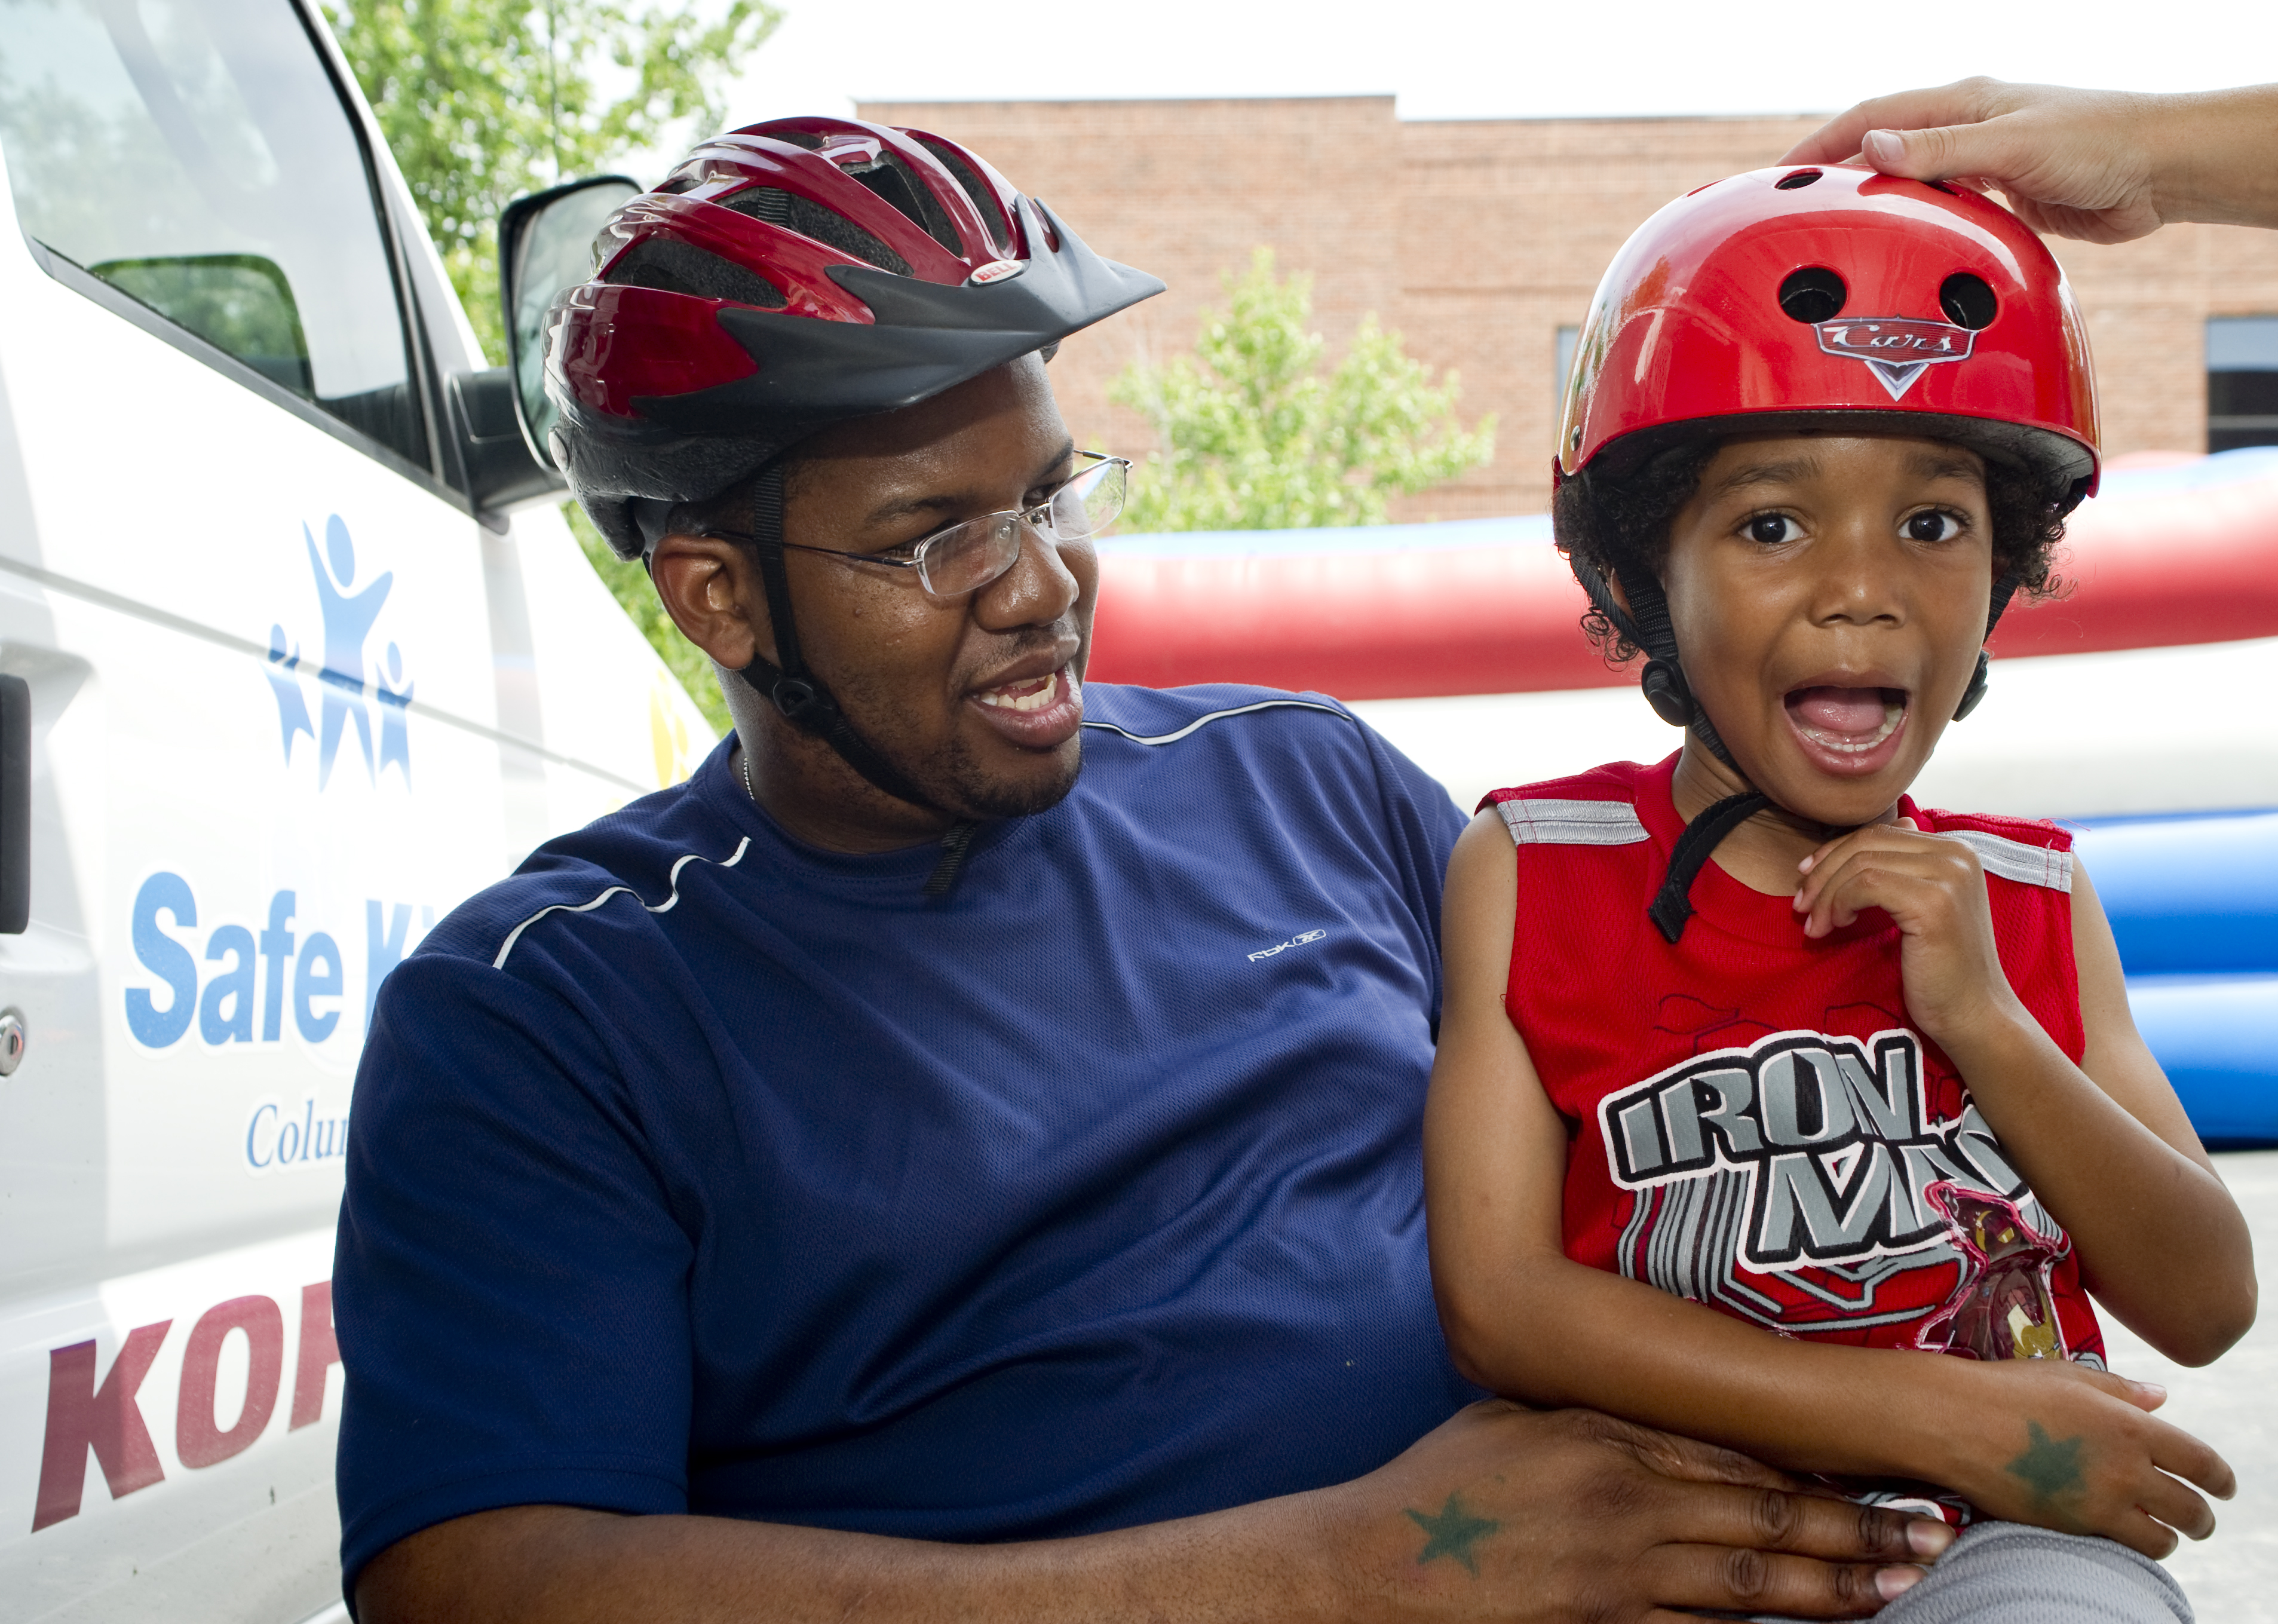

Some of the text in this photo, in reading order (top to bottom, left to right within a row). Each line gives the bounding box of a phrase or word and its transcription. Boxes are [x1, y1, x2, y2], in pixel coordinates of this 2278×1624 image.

[974, 262, 1017, 281] BELL
[1823, 324, 1956, 354] Cars
[125, 871, 344, 1049] Safe
[1603, 1032, 1925, 1184] IRON
